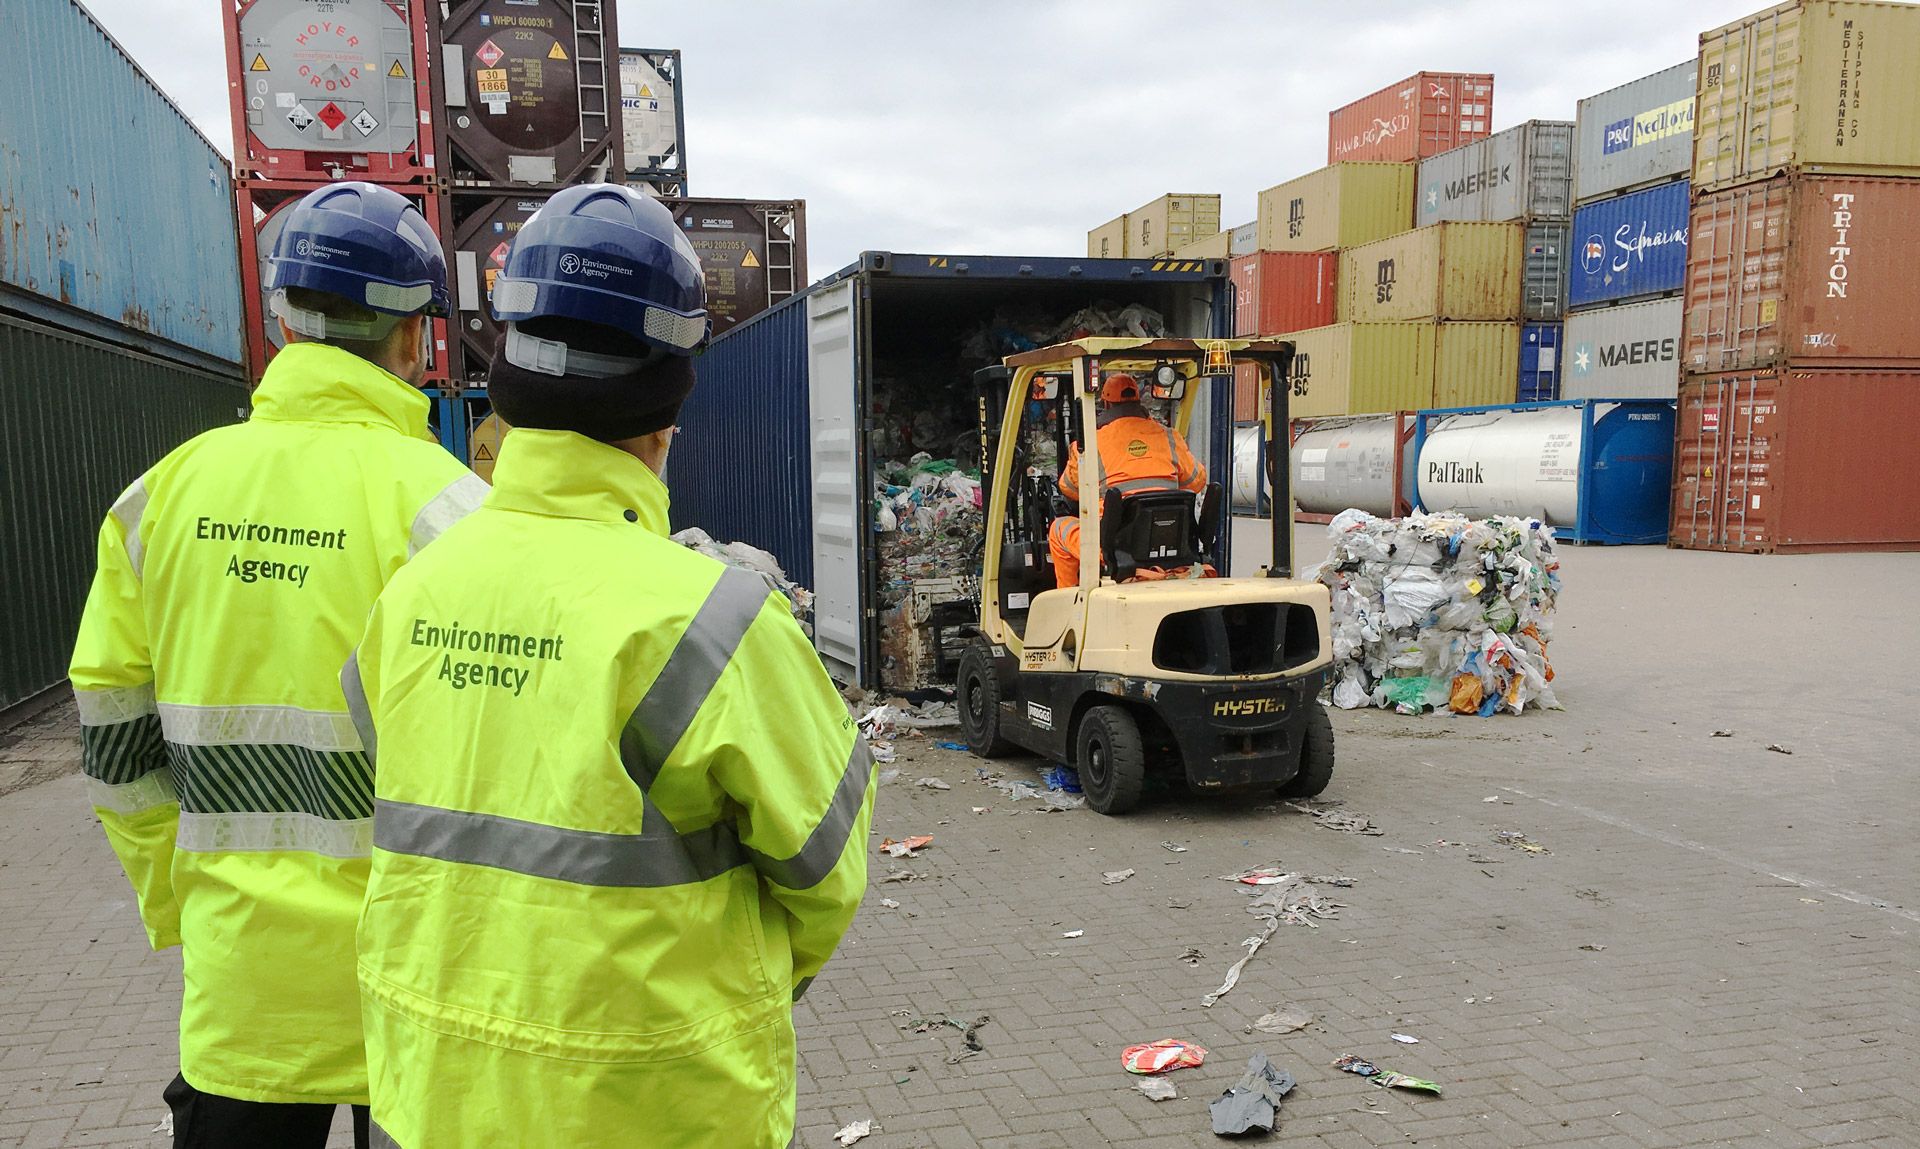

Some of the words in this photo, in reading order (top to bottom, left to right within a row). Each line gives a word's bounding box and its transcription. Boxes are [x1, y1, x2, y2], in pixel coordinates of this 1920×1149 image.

[493, 15, 517, 25] WHPU
[296, 21, 359, 47] HOYER
[514, 31, 534, 40] 22K2
[298, 65, 360, 91] GROUP
[485, 70, 498, 80] 30
[1852, 31, 1864, 109] SHIPPING
[481, 81, 506, 91] 1866
[1836, 20, 1853, 147] MEDITERRANEAN
[1636, 103, 1694, 138] Nedlloyd
[1851, 119, 1858, 138] CO
[1444, 163, 1511, 202] MAERSK
[506, 221, 524, 231] WHP
[311, 242, 351, 256] Environment
[311, 250, 331, 260] Agency
[692, 240, 713, 249] WHPU
[714, 240, 740, 249] 200205
[1826, 193, 1854, 298] TRITON
[580, 266, 610, 280] Agency
[582, 258, 633, 276] Environment
[1599, 337, 1681, 368] MAERS
[1703, 413, 1718, 421] TAL
[980, 396, 989, 474] HYSTER
[1428, 461, 1484, 484] PalTank
[196, 516, 348, 550] Environment
[225, 554, 310, 589] Agency
[411, 618, 564, 661] Environment
[1024, 651, 1047, 662] HYSTER
[438, 653, 530, 697] Agency
[1213, 697, 1286, 716] HYSTER
